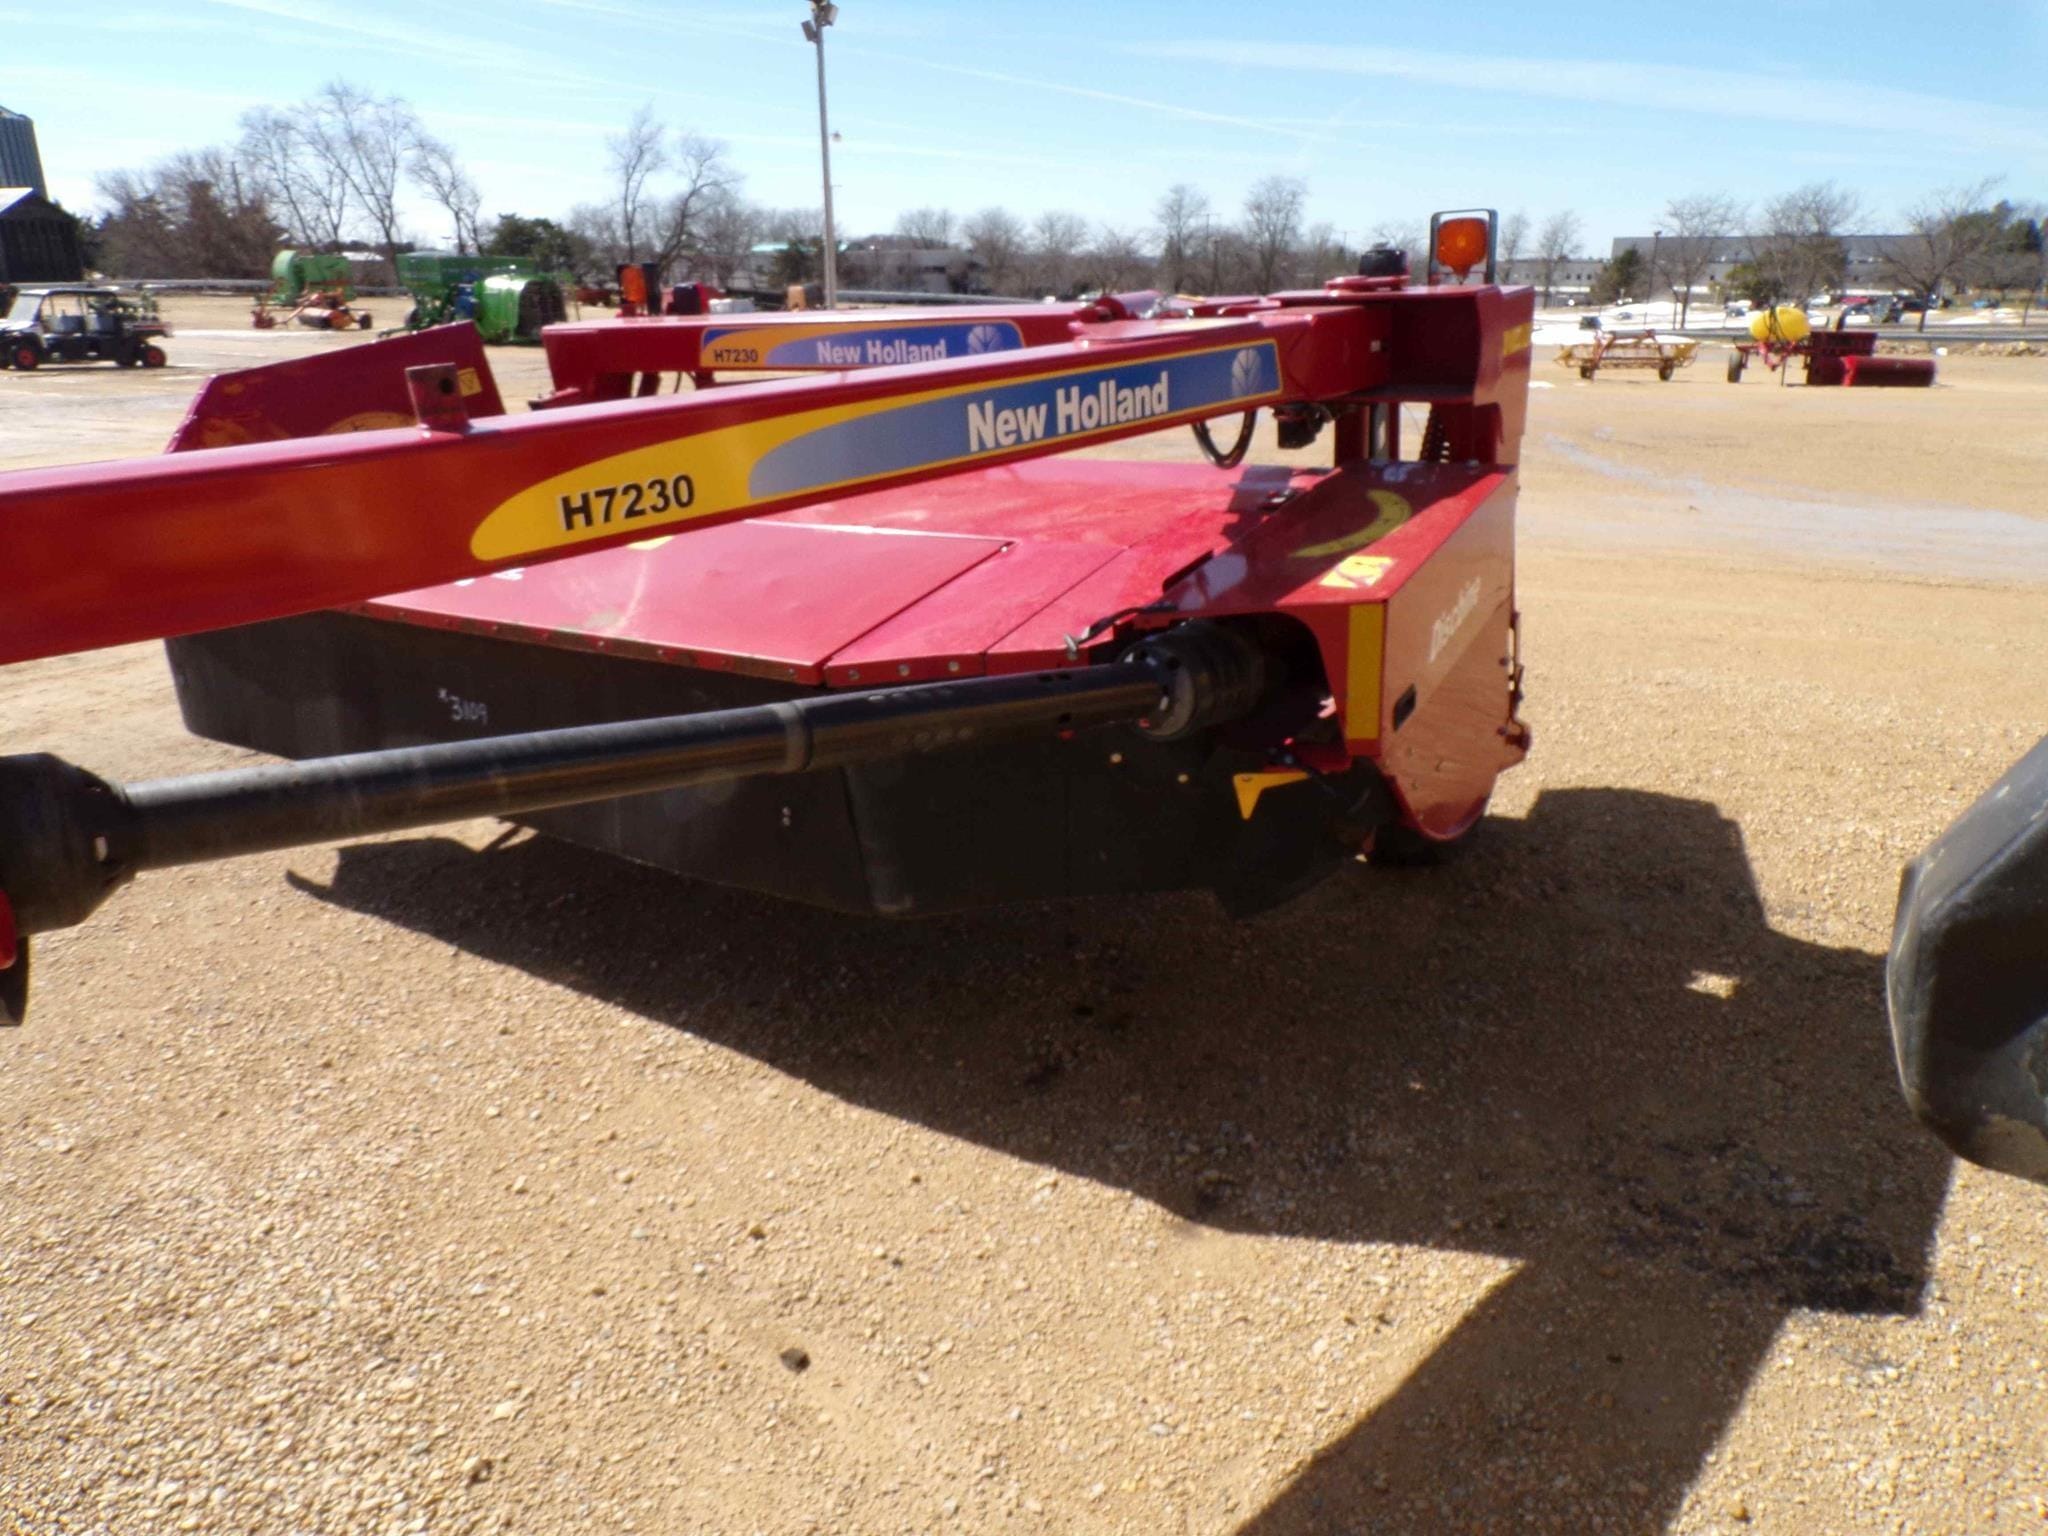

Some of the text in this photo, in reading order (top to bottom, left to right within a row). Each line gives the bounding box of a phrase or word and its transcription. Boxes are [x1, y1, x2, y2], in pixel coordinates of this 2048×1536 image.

[713, 348, 758, 363] H7230
[816, 338, 947, 364] New Holland
[967, 370, 1169, 452] New Holland
[560, 474, 695, 531] H7230
